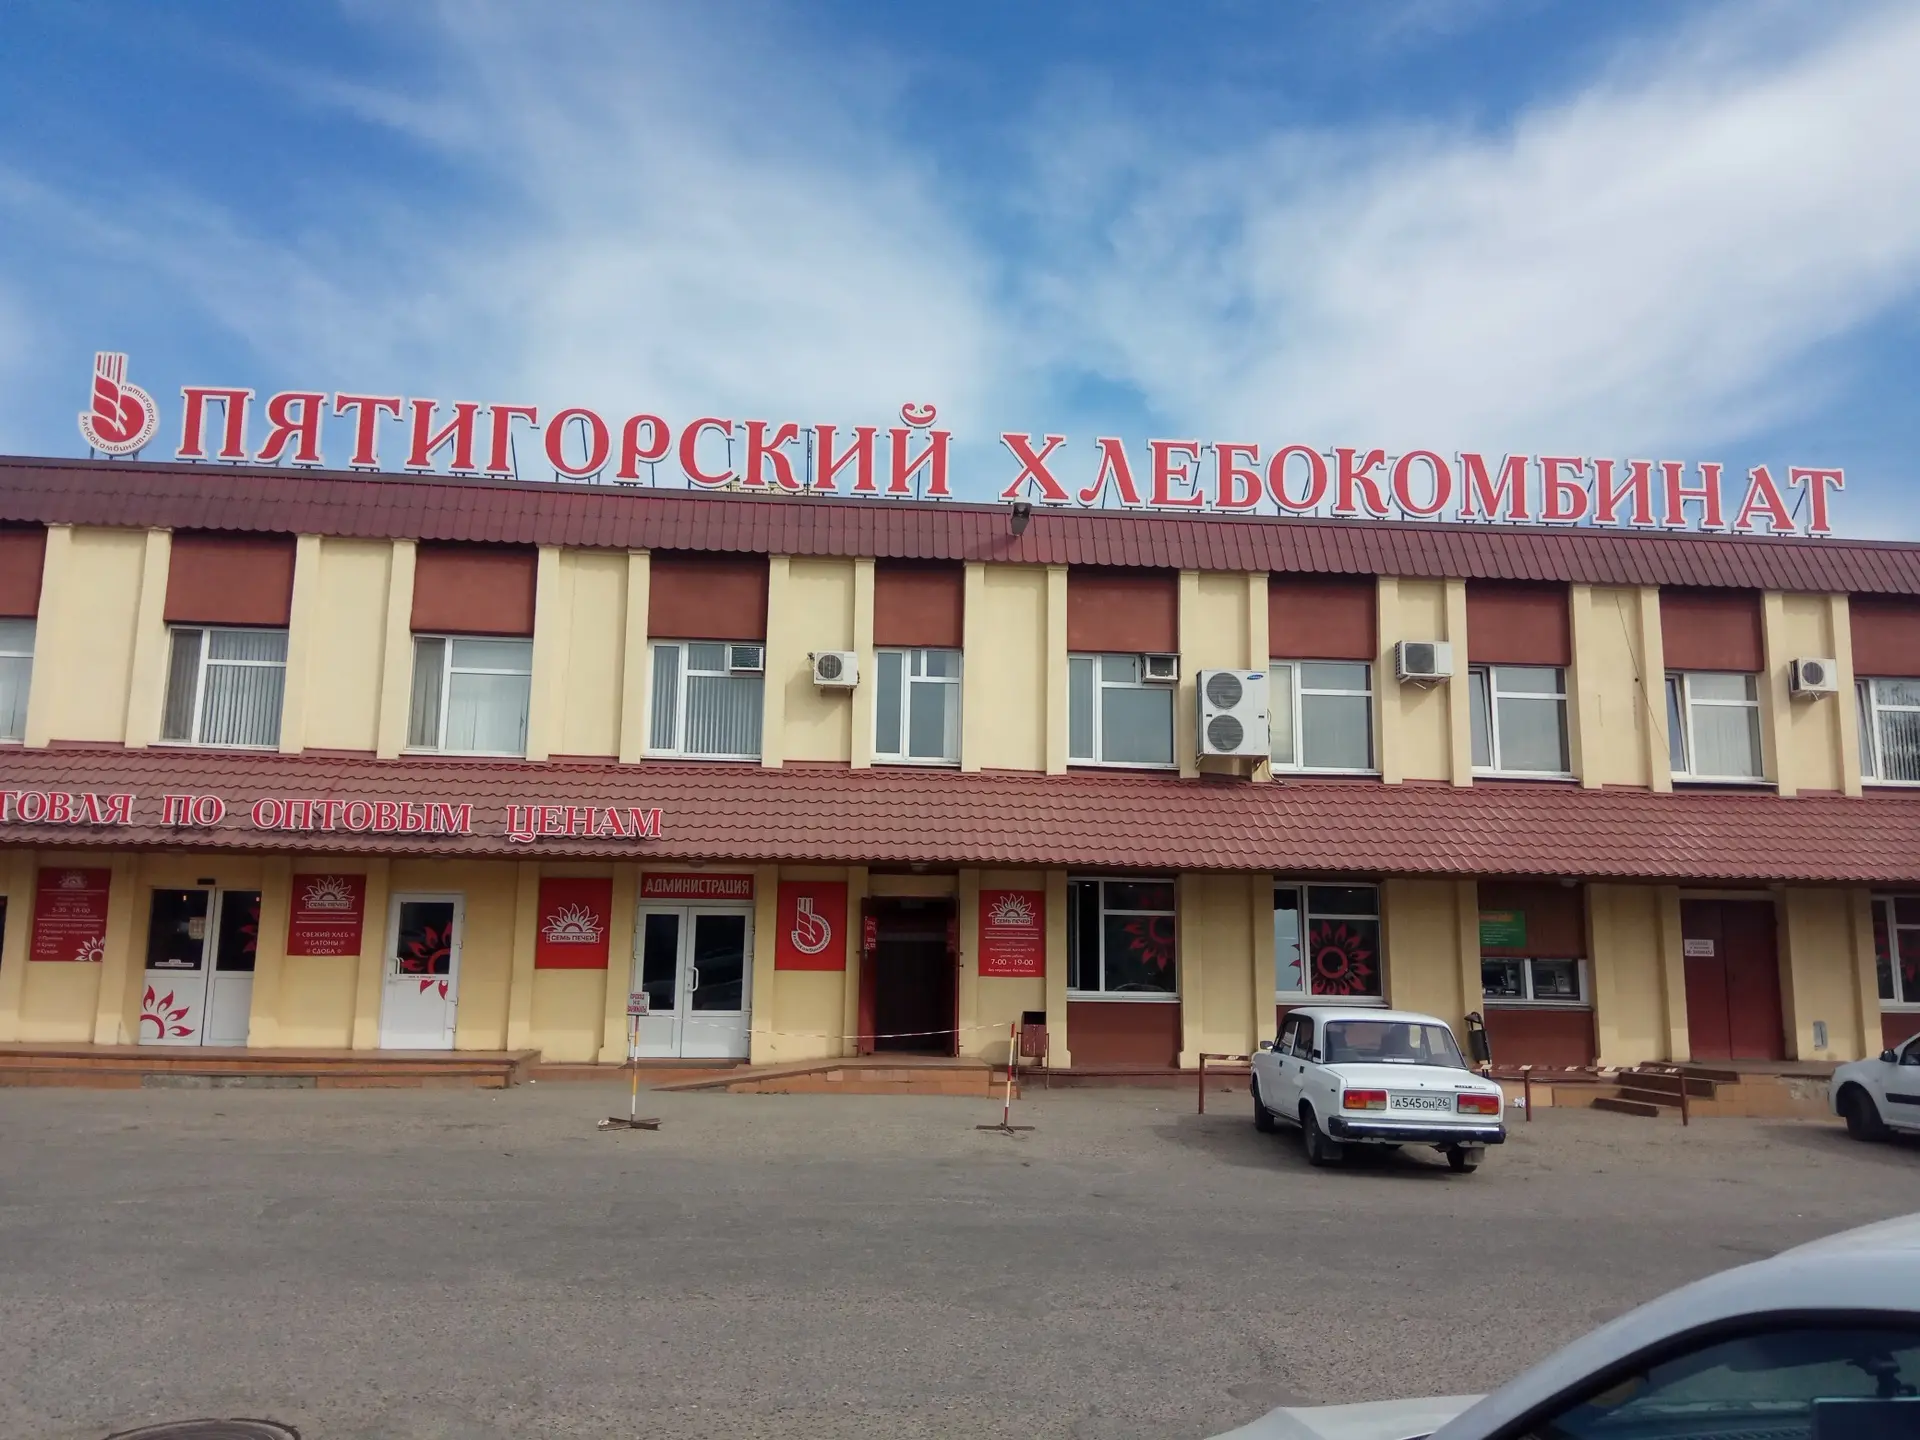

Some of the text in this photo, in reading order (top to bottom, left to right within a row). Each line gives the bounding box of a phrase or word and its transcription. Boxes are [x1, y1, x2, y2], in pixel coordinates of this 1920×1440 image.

[177, 387, 1846, 537] ПЯТИГОРСКИЙ ХЛЕБОКОМБИНАТ
[161, 794, 227, 826] ПО
[252, 798, 473, 833] ОПТОВЫМ
[505, 804, 664, 842] ЦЕНАМ
[645, 878, 750, 895] АДМИНИСТРАЦИЯ
[572, 933, 595, 941] ПЕЧЕЙ
[990, 958, 1007, 966] 7-00
[1394, 1097, 1447, 1109] А545ОН 26
